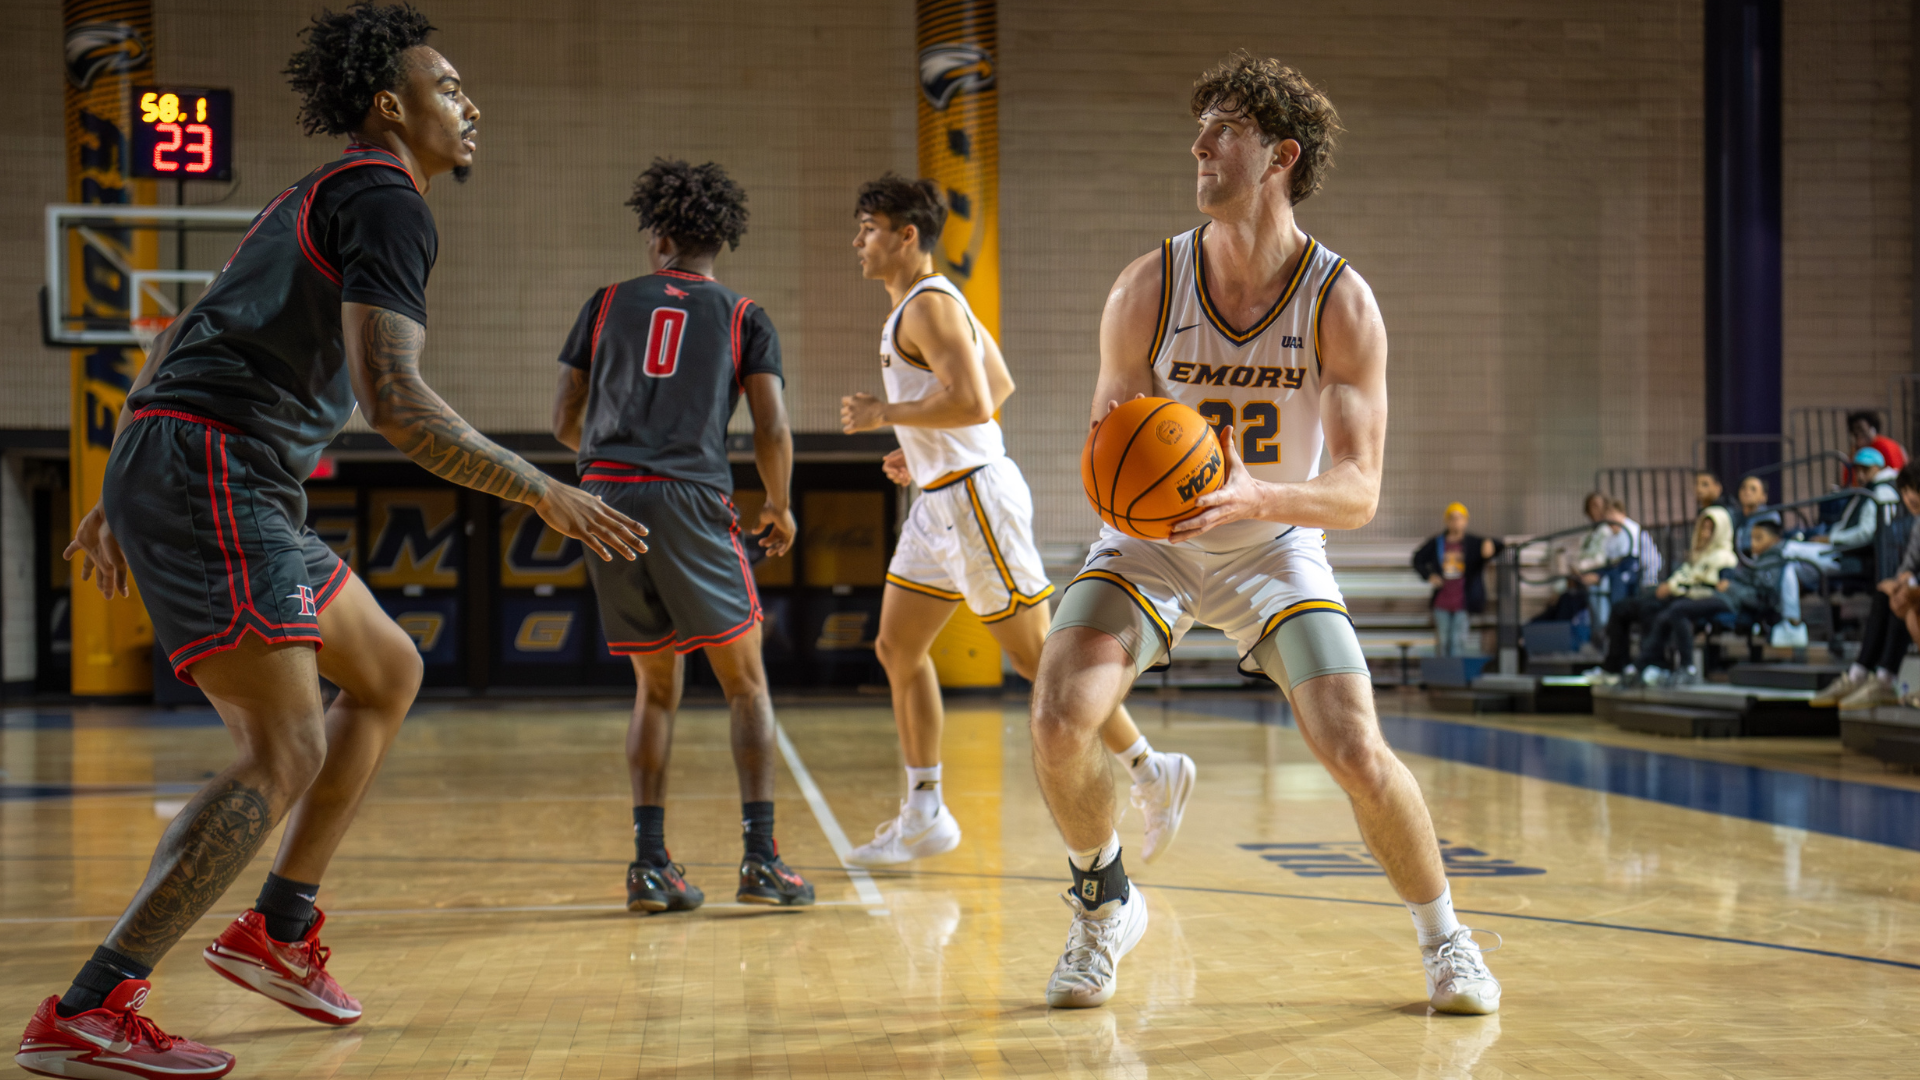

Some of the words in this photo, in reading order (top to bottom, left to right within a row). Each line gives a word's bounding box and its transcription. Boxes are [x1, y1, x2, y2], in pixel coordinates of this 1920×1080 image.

[140, 92, 207, 123] 58.1
[153, 122, 213, 173] 23
[642, 306, 689, 378] 0
[1281, 335, 1304, 349] UAA
[1167, 361, 1307, 389] EMORY
[1176, 448, 1222, 503] NCAA
